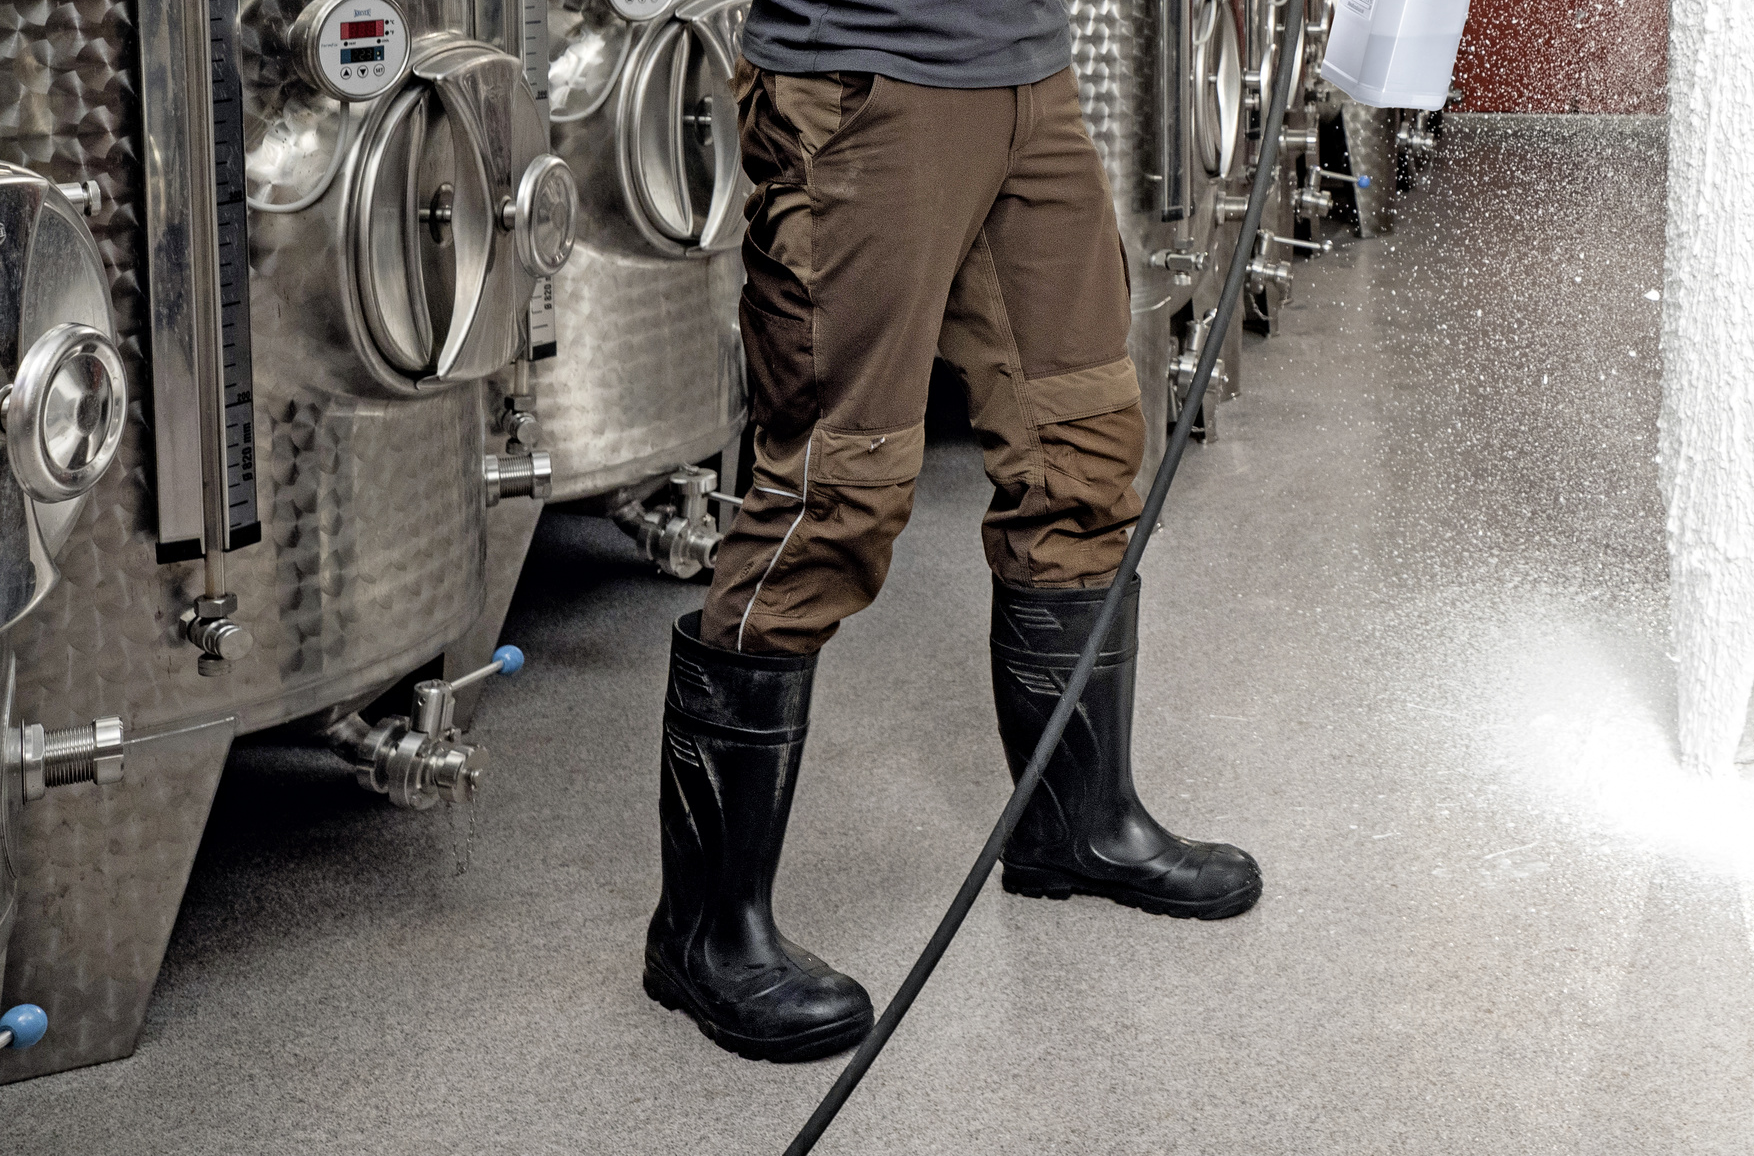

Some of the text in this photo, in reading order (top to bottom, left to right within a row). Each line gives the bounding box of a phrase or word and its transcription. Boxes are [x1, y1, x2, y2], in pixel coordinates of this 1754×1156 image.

[543, 284, 552, 301] 820
[237, 390, 251, 403] 200
[242, 446, 252, 470] 820
